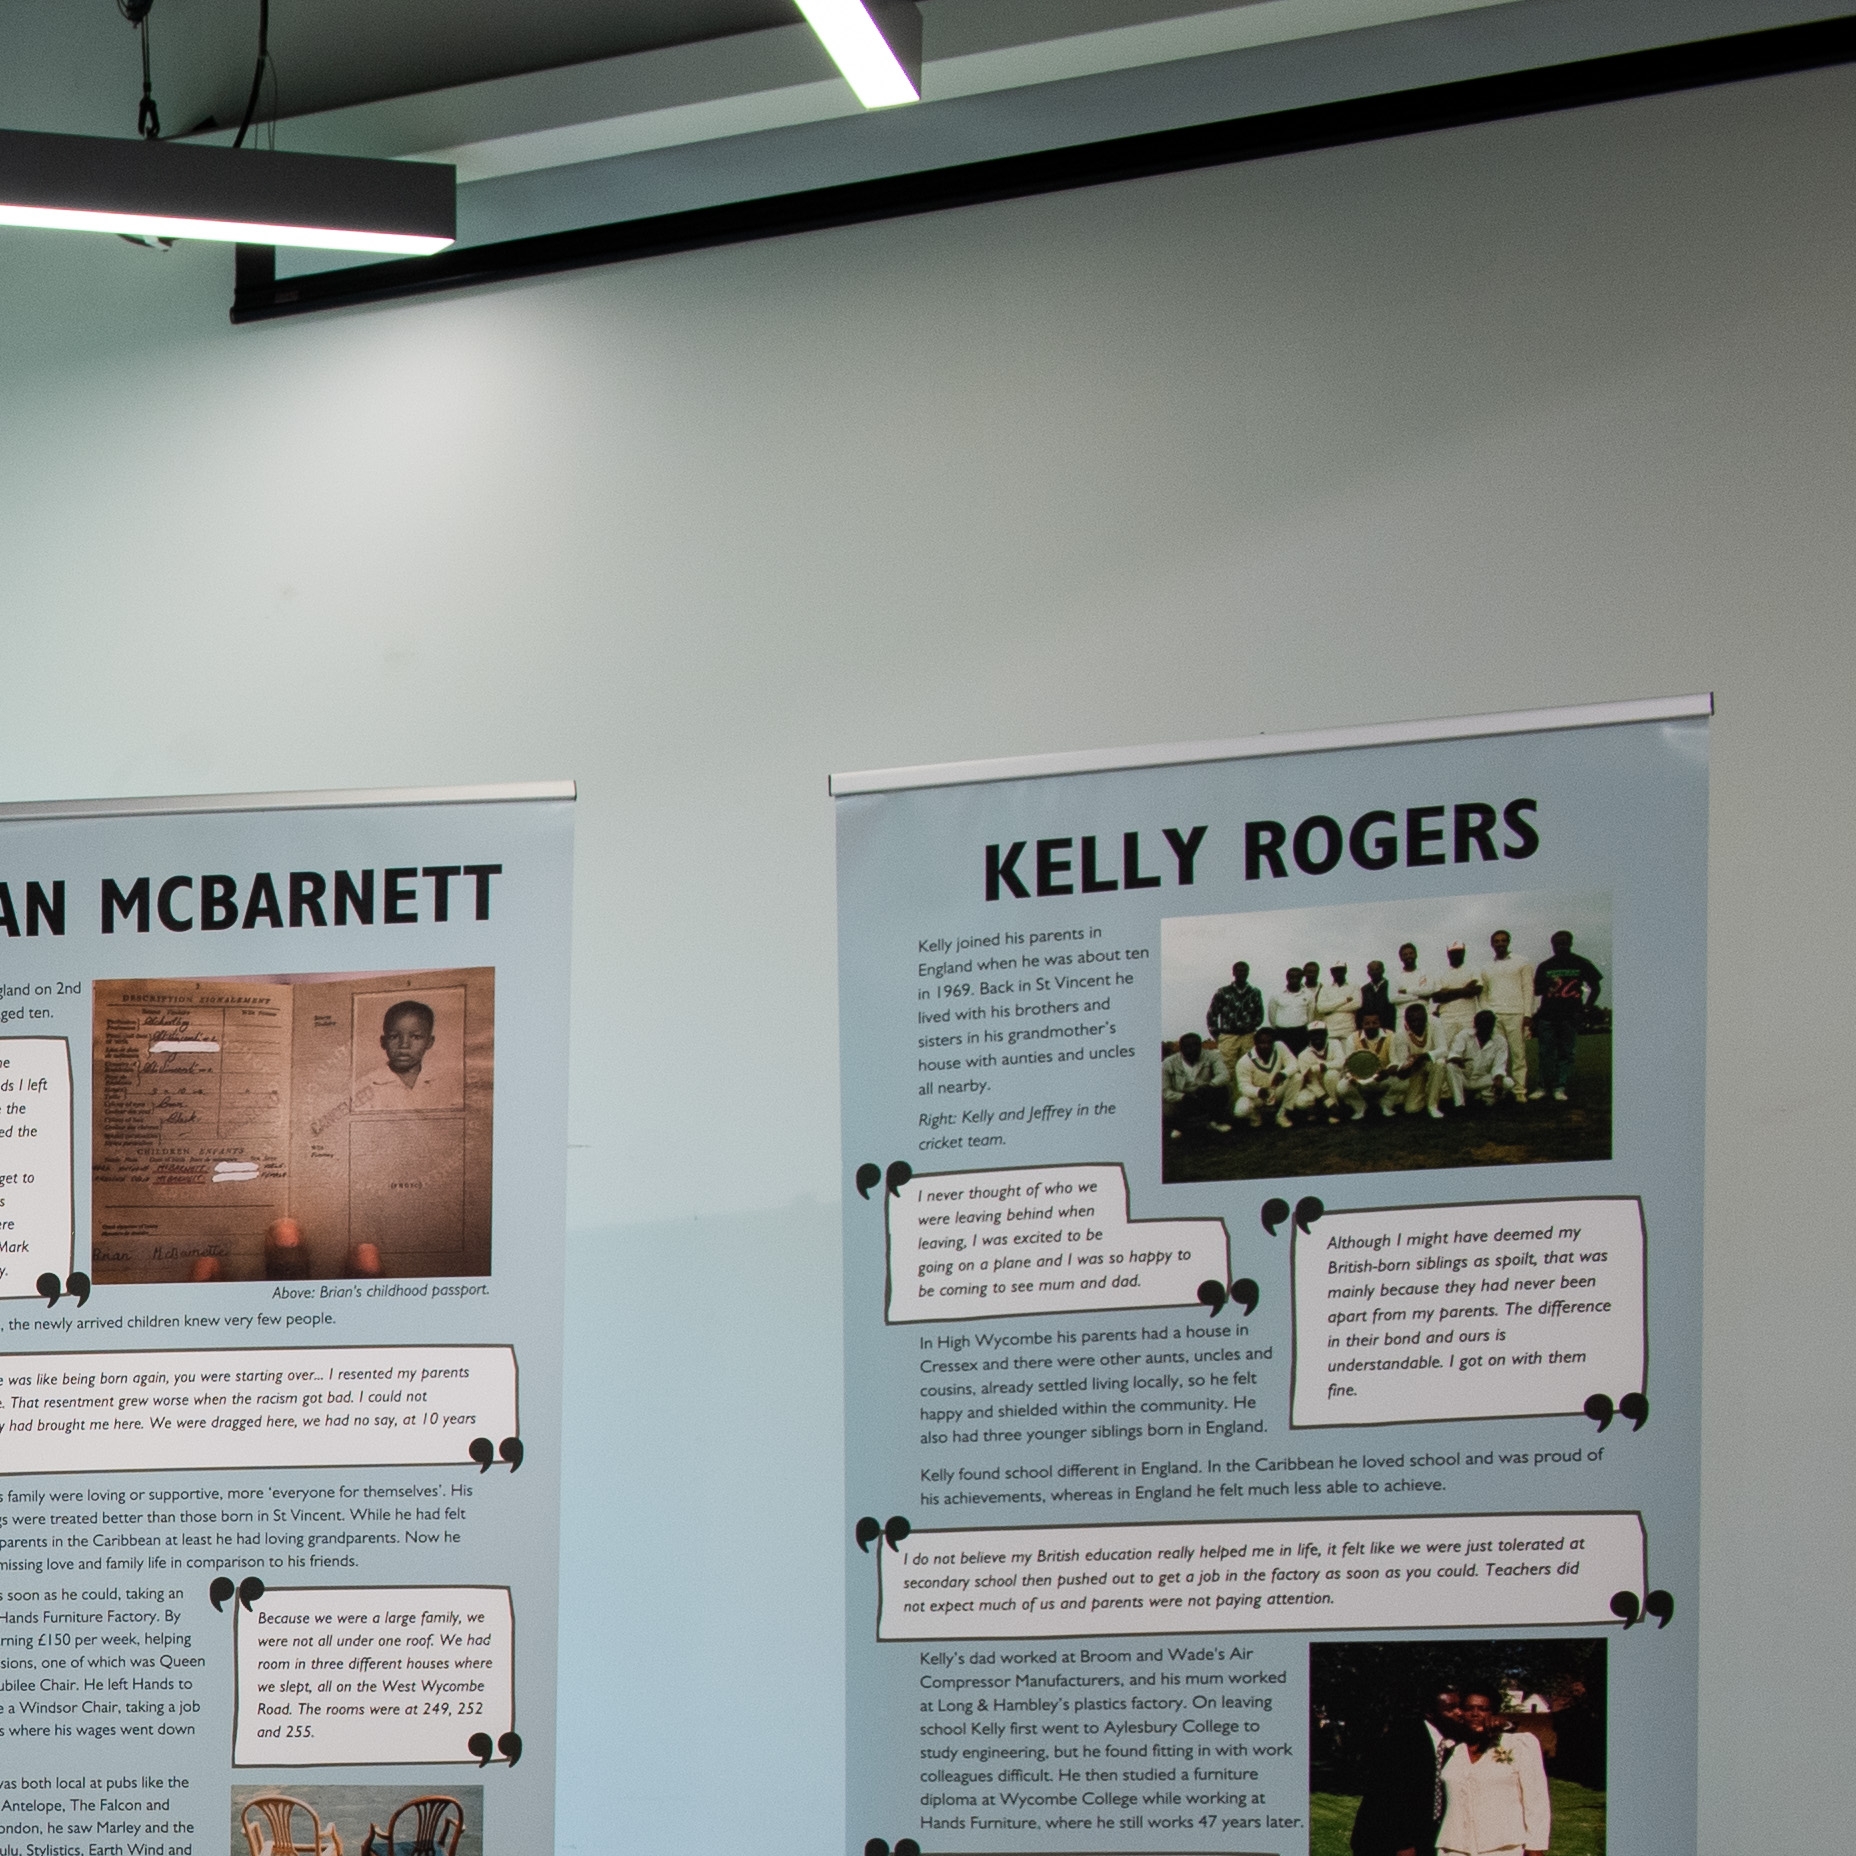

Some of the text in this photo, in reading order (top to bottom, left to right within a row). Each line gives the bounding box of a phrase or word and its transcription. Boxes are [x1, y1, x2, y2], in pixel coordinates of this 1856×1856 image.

[985, 797, 1539, 902] KELLY ROGERS
[101, 863, 503, 934] MCBARNETT
[34, 985, 52, 996] on
[56, 981, 82, 995] 2nd
[918, 971, 1134, 1000] in 1969. Back in St Vincent he
[271, 1283, 490, 1300] Above: Brian's childhood passport.
[1327, 1382, 1358, 1400] fine.
[256, 1724, 315, 1738] and 255.
[920, 1814, 1304, 1832] Hands Furniture, where he still works 47 years later.
